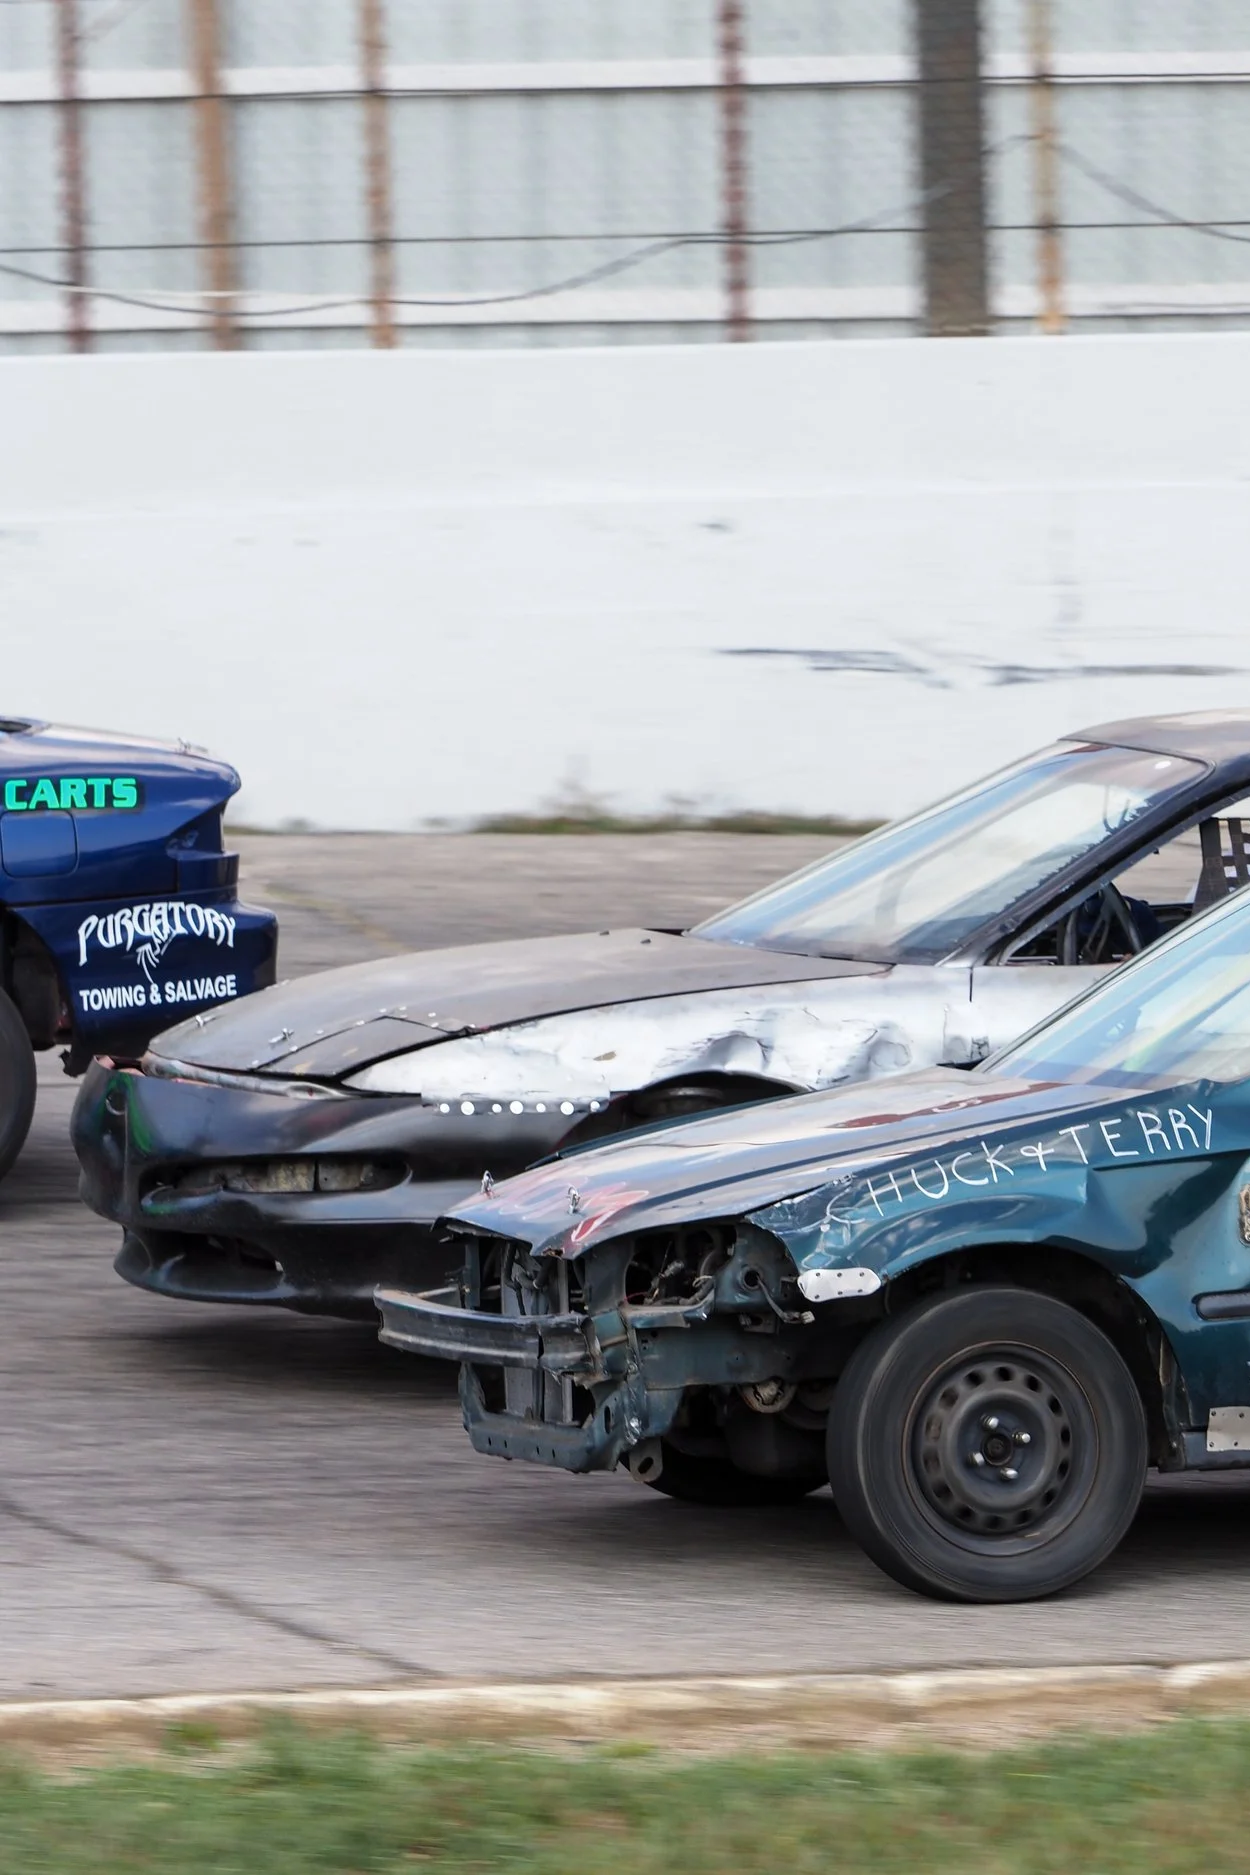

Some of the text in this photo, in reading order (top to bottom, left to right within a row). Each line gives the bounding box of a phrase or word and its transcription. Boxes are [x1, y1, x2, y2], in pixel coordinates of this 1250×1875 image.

[4, 777, 138, 811] CARTS
[77, 900, 236, 967] PURGATORY
[79, 974, 238, 1012] TOWING & SALVAGE
[1058, 1102, 1213, 1165] TERRY
